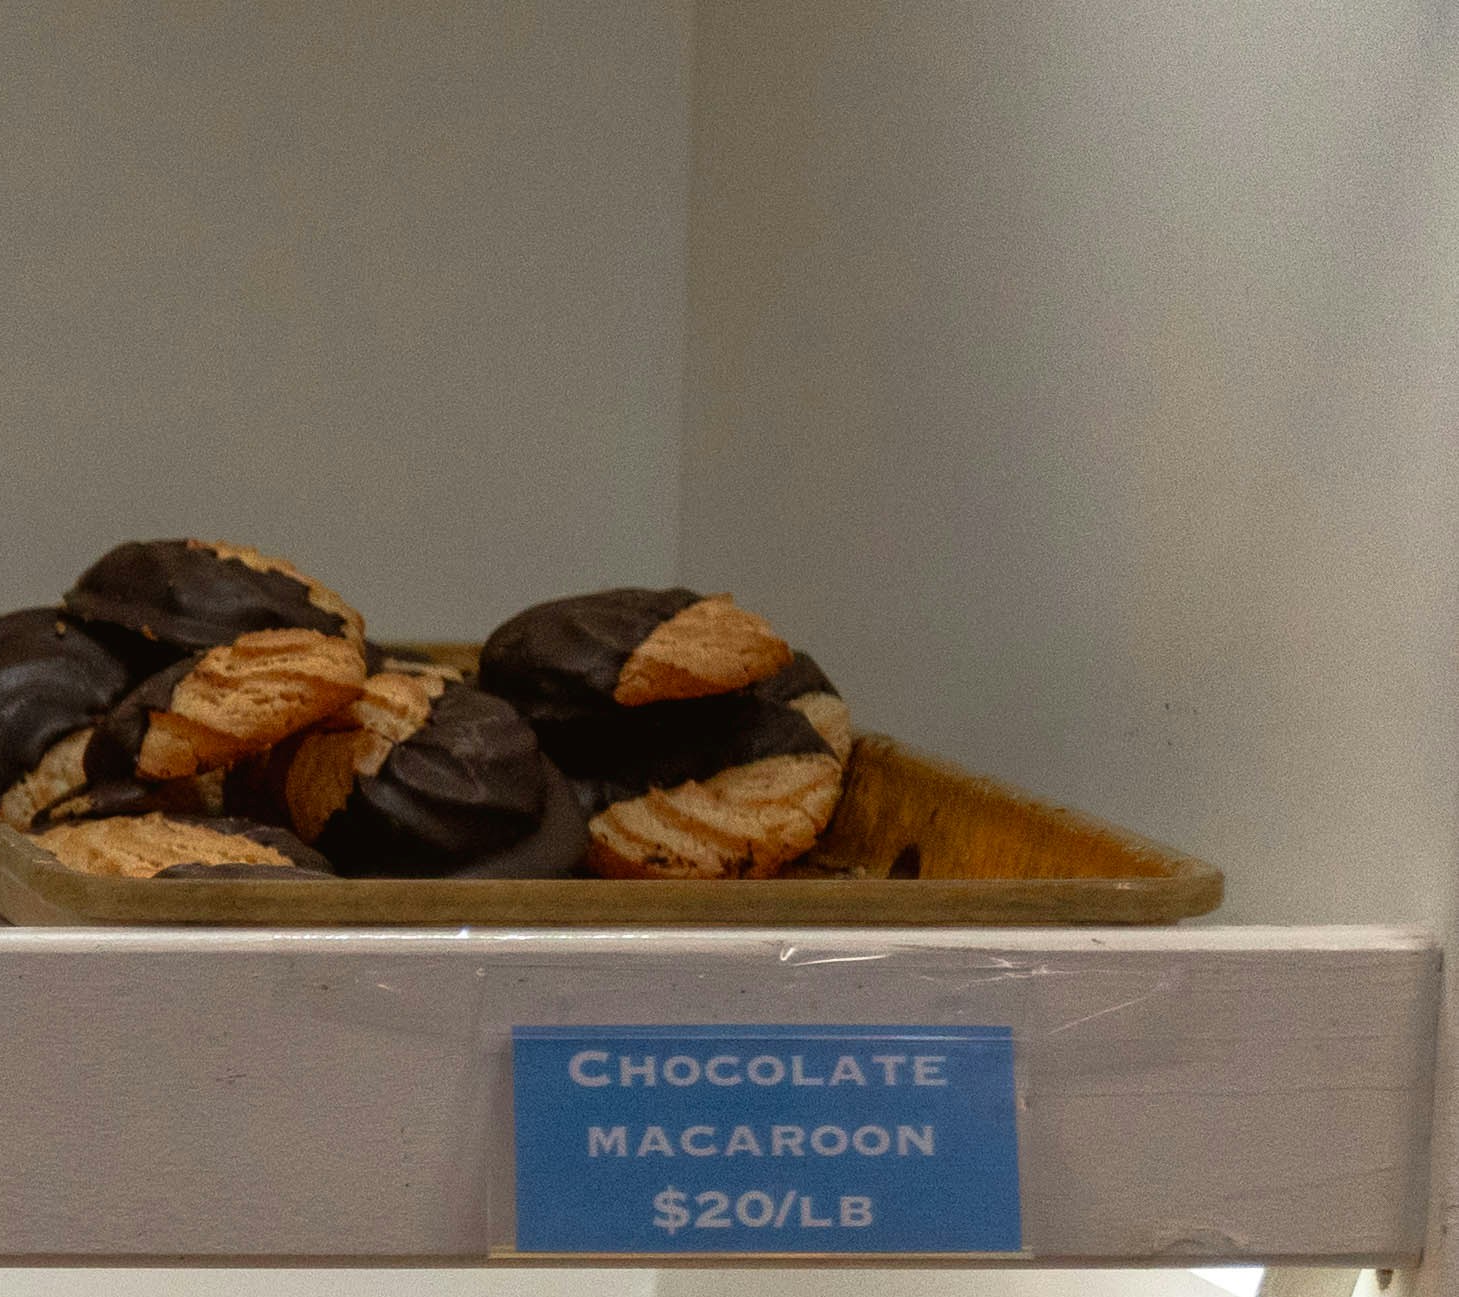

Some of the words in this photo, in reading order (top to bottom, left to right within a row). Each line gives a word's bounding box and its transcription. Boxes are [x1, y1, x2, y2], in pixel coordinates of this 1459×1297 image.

[568, 1050, 948, 1087] CHOCOLATE
[588, 1123, 935, 1157] MACAROON
[653, 1186, 874, 1235] $20/LB
